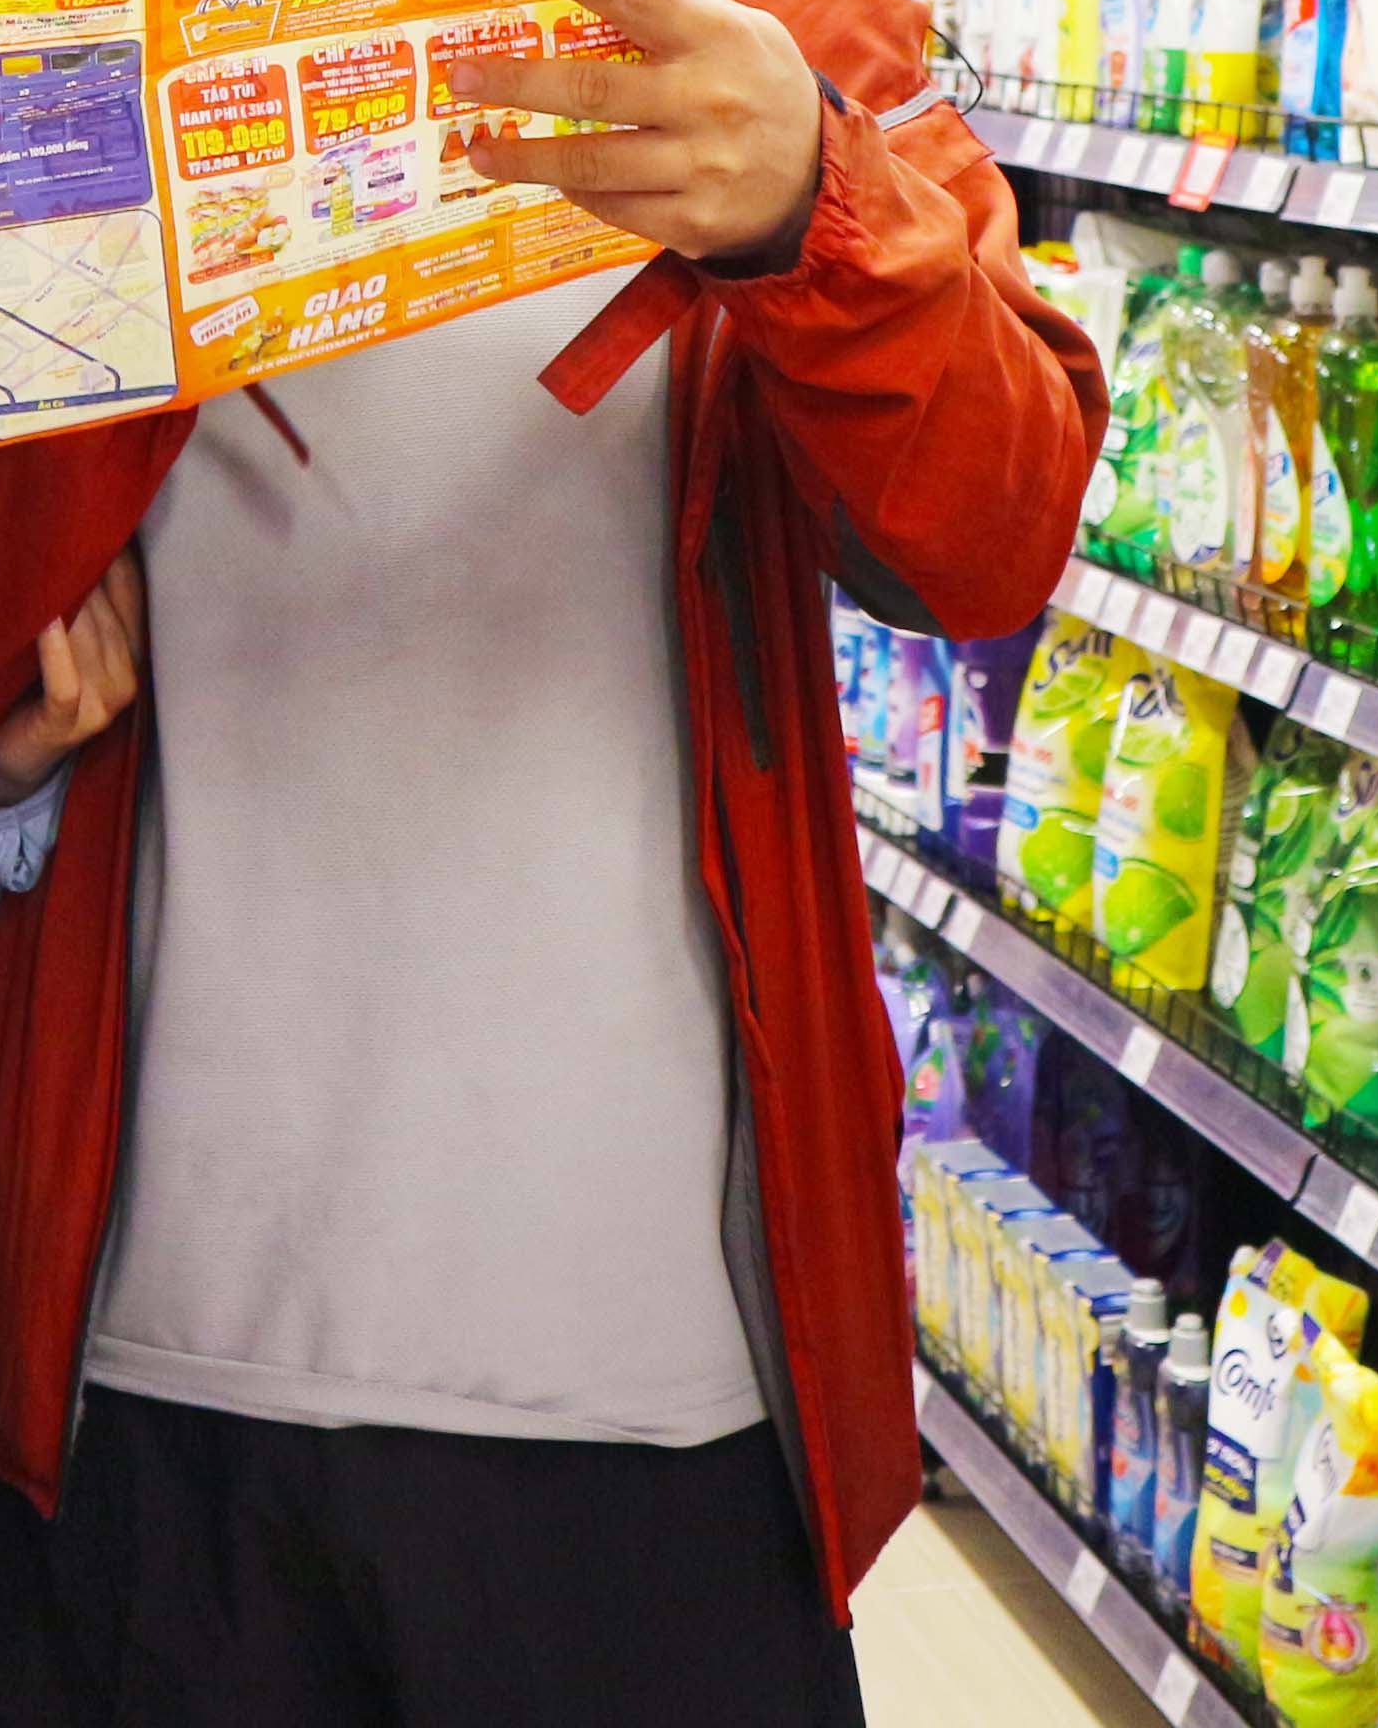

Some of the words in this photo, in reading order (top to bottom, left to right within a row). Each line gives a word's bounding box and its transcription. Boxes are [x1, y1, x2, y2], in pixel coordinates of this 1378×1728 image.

[179, 108, 211, 127] NAM
[214, 105, 238, 122] PHI
[314, 95, 406, 135] 79.000
[181, 119, 286, 159] 119.000
[303, 274, 388, 319] GIAO
[287, 300, 388, 352] HÀNG
